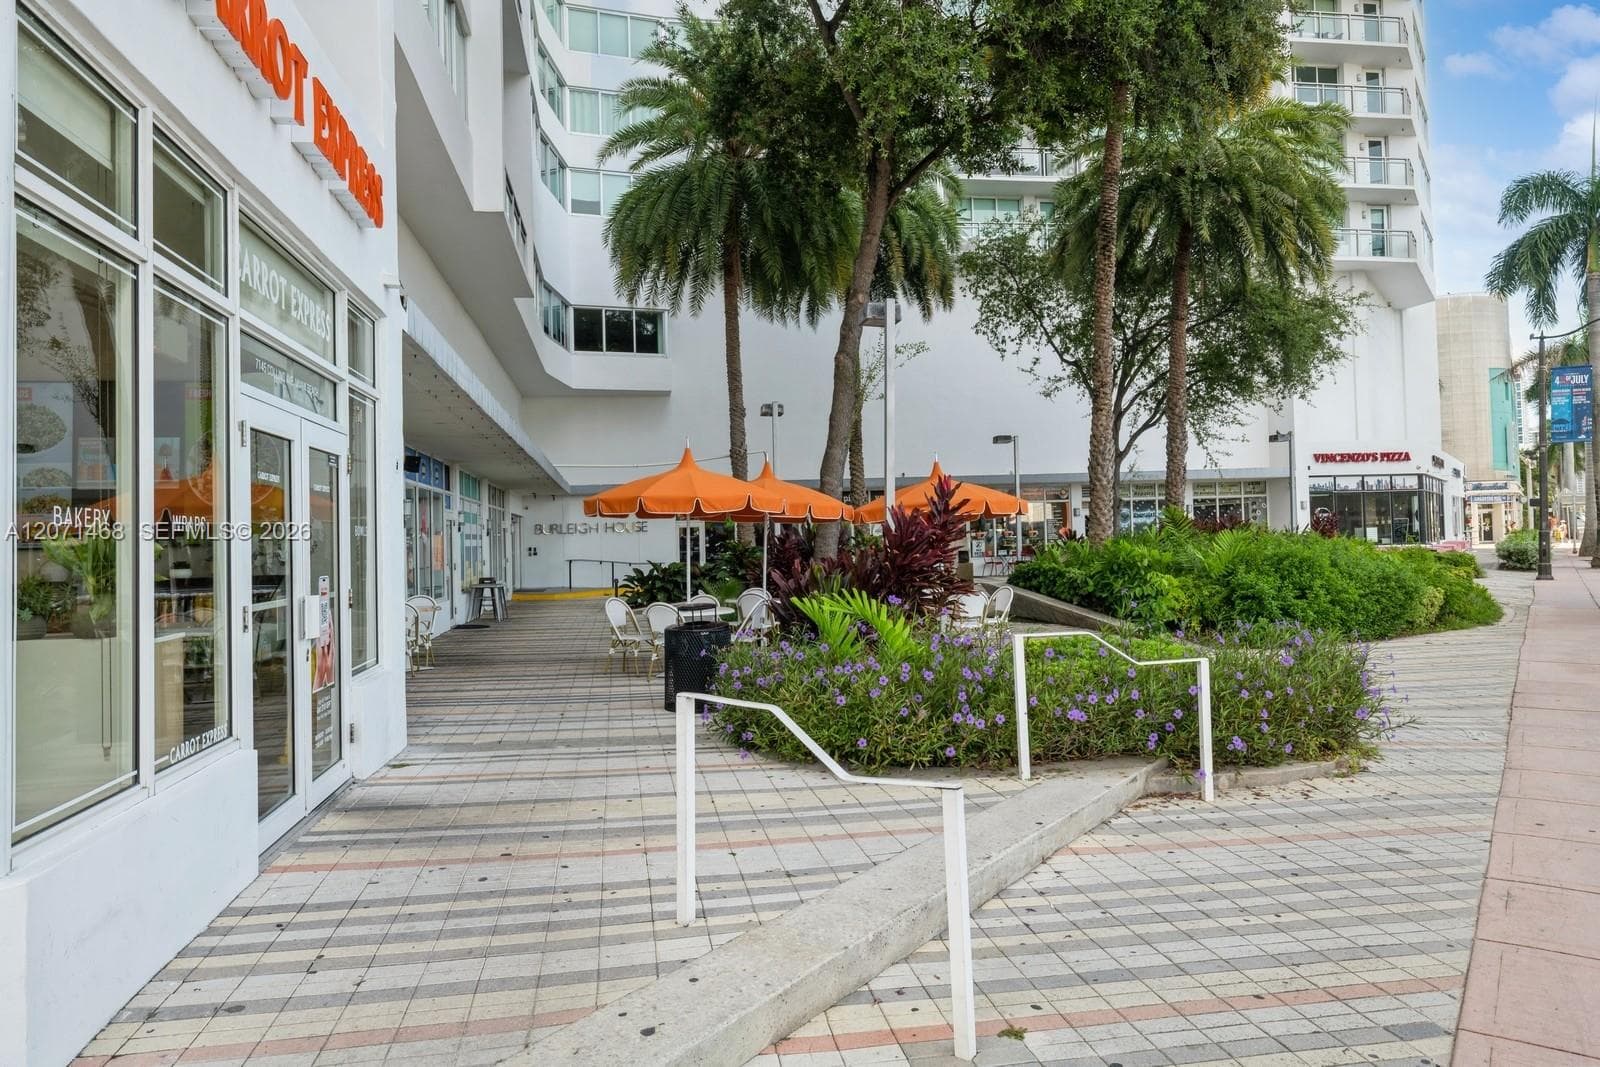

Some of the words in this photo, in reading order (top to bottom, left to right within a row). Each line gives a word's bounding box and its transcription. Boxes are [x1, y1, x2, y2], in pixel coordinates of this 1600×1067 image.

[215, 0, 309, 126] RROT
[312, 76, 383, 228] EXPRESS
[239, 247, 287, 310] ARROT
[290, 284, 330, 342] EXPRESS
[1570, 374, 1590, 385] JULY
[1313, 452, 1378, 463] VINCENZO'S
[1379, 451, 1411, 462] PIZZA
[53, 505, 112, 532] BAKERY
[171, 513, 208, 533] WRAPS
[534, 522, 598, 535] BURLEIGH
[604, 520, 648, 533] HOUSE
[170, 735, 200, 764] CARROT
[202, 722, 228, 750] EXPRESS
